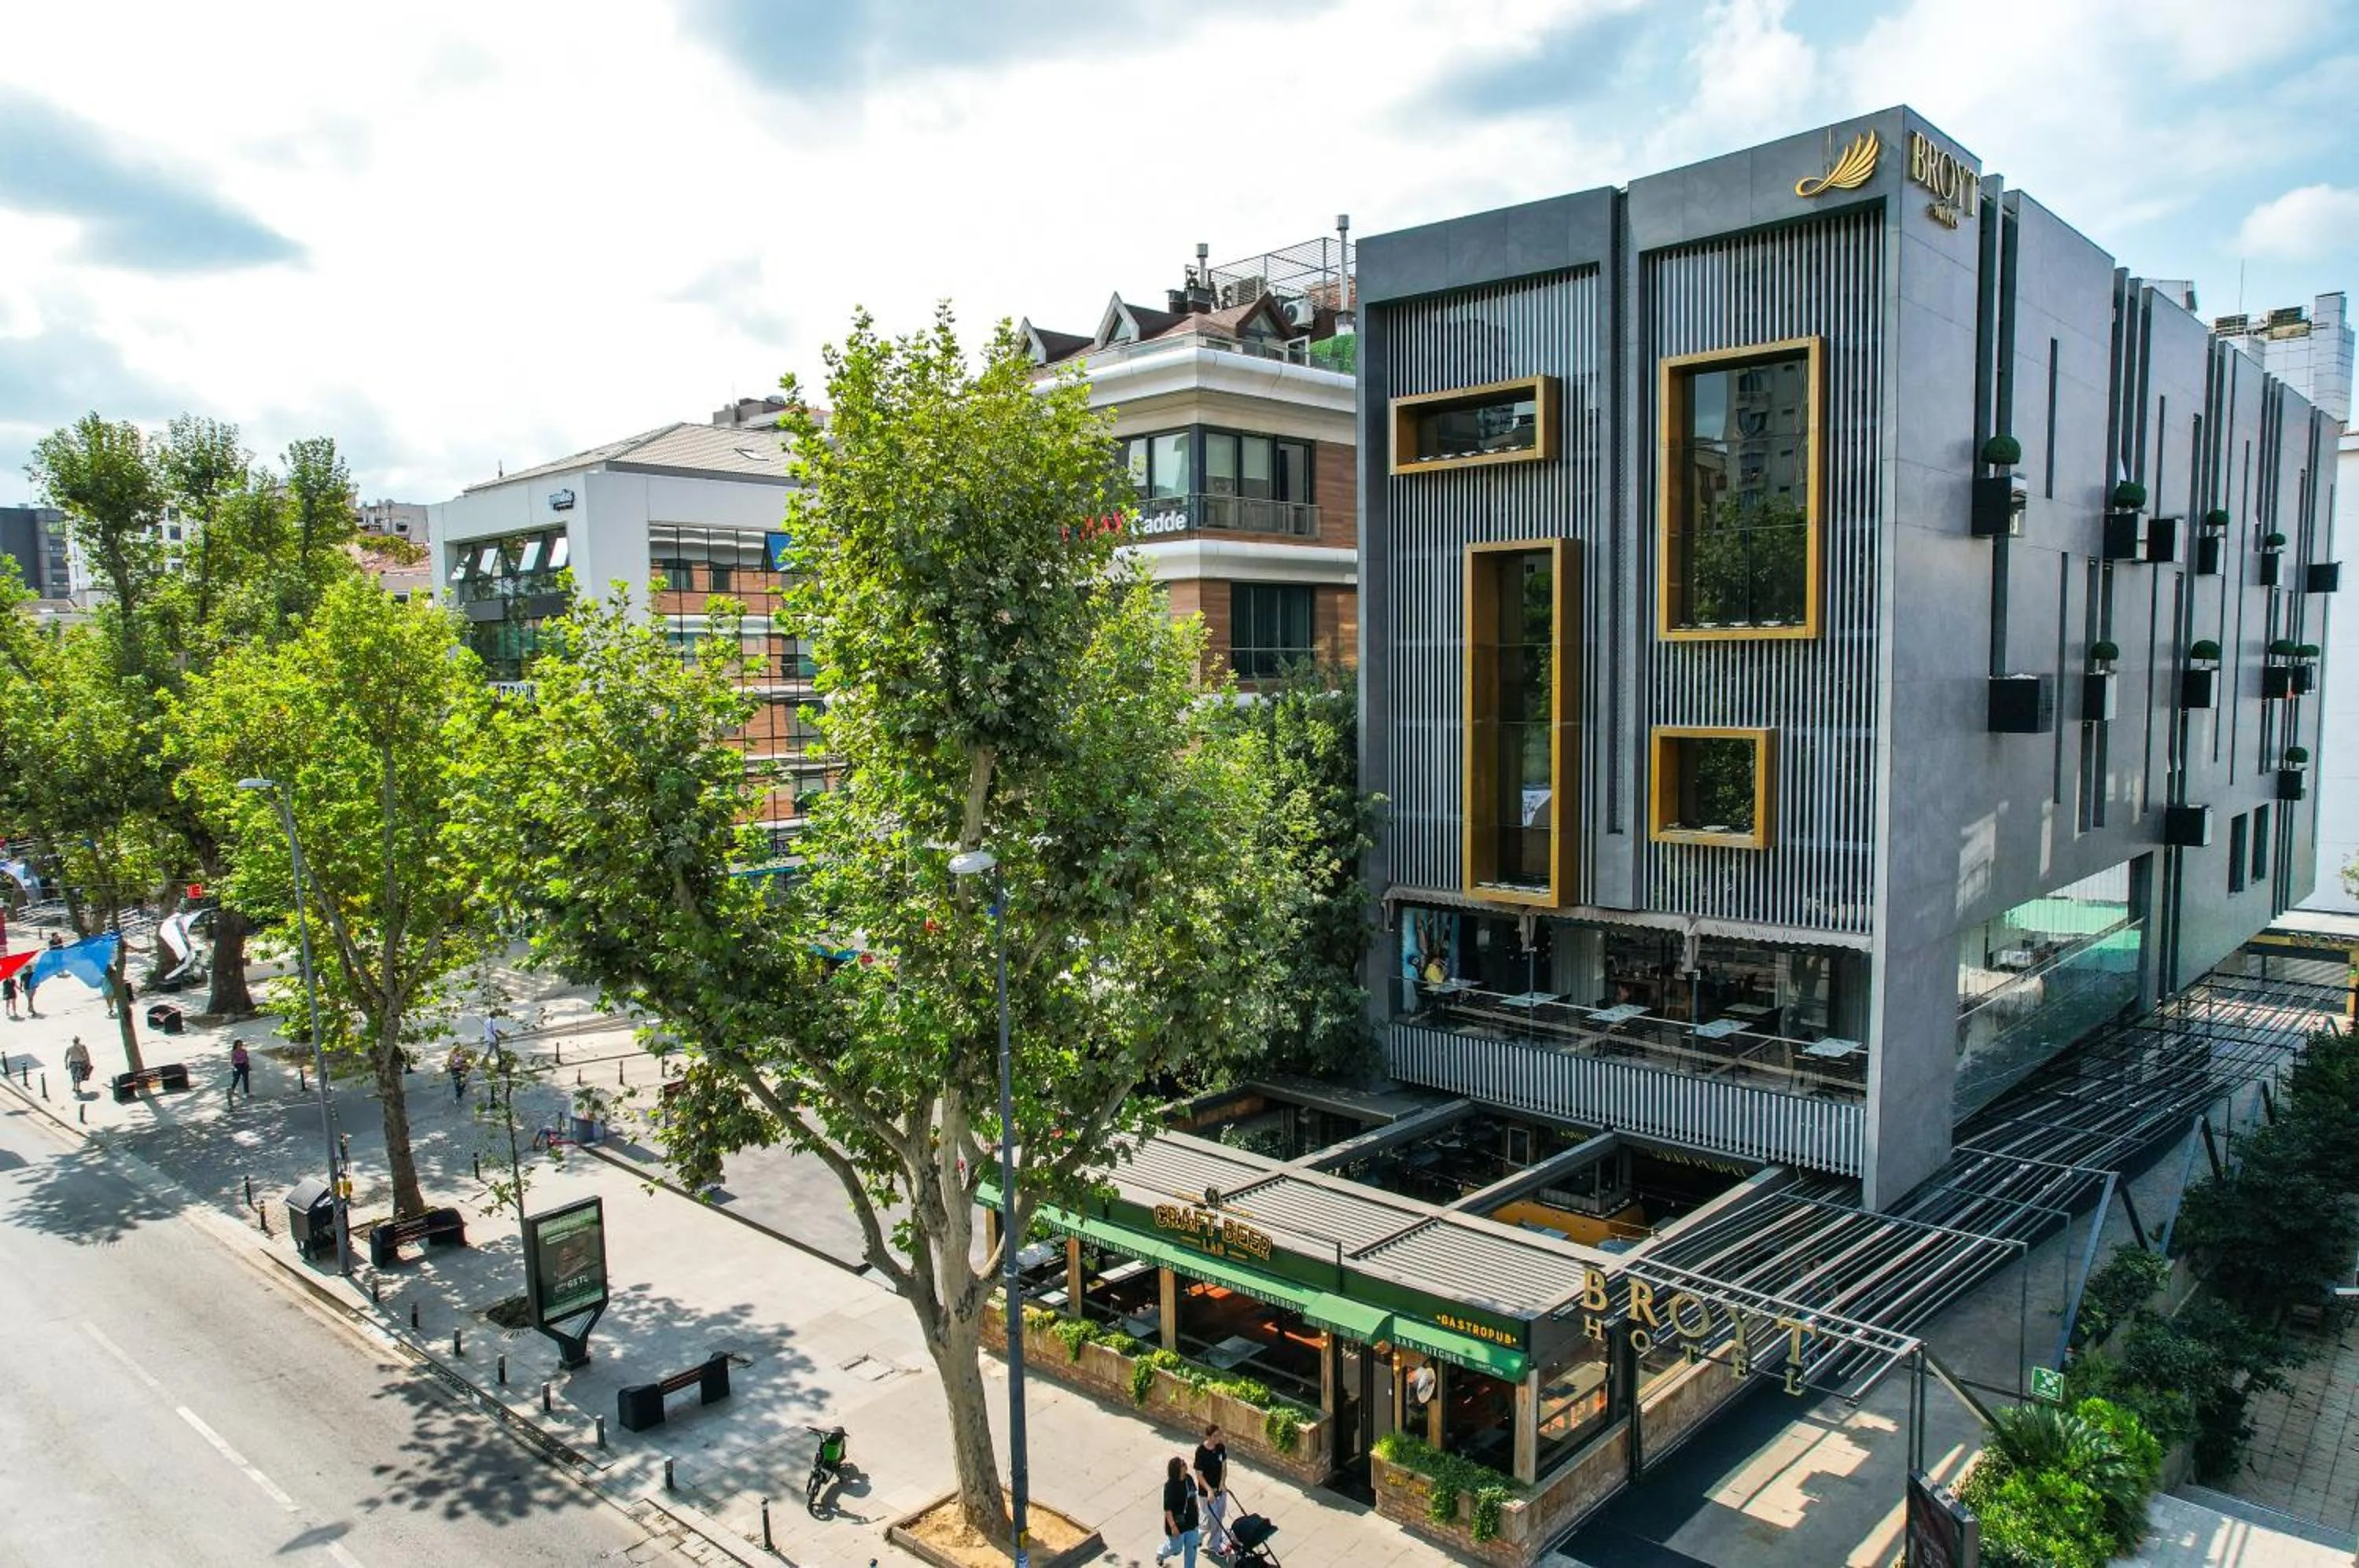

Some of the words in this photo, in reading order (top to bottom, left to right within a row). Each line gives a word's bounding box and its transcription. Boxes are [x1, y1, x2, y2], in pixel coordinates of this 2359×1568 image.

[1912, 131, 1980, 216] BROYT
[1154, 1203, 1215, 1237] CRAFT
[1223, 1217, 1274, 1261] BEER
[1440, 1314, 1514, 1345] GASTROPUB
[1580, 1266, 1820, 1364] BROYT
[1582, 1314, 1805, 1397] HOTEL
